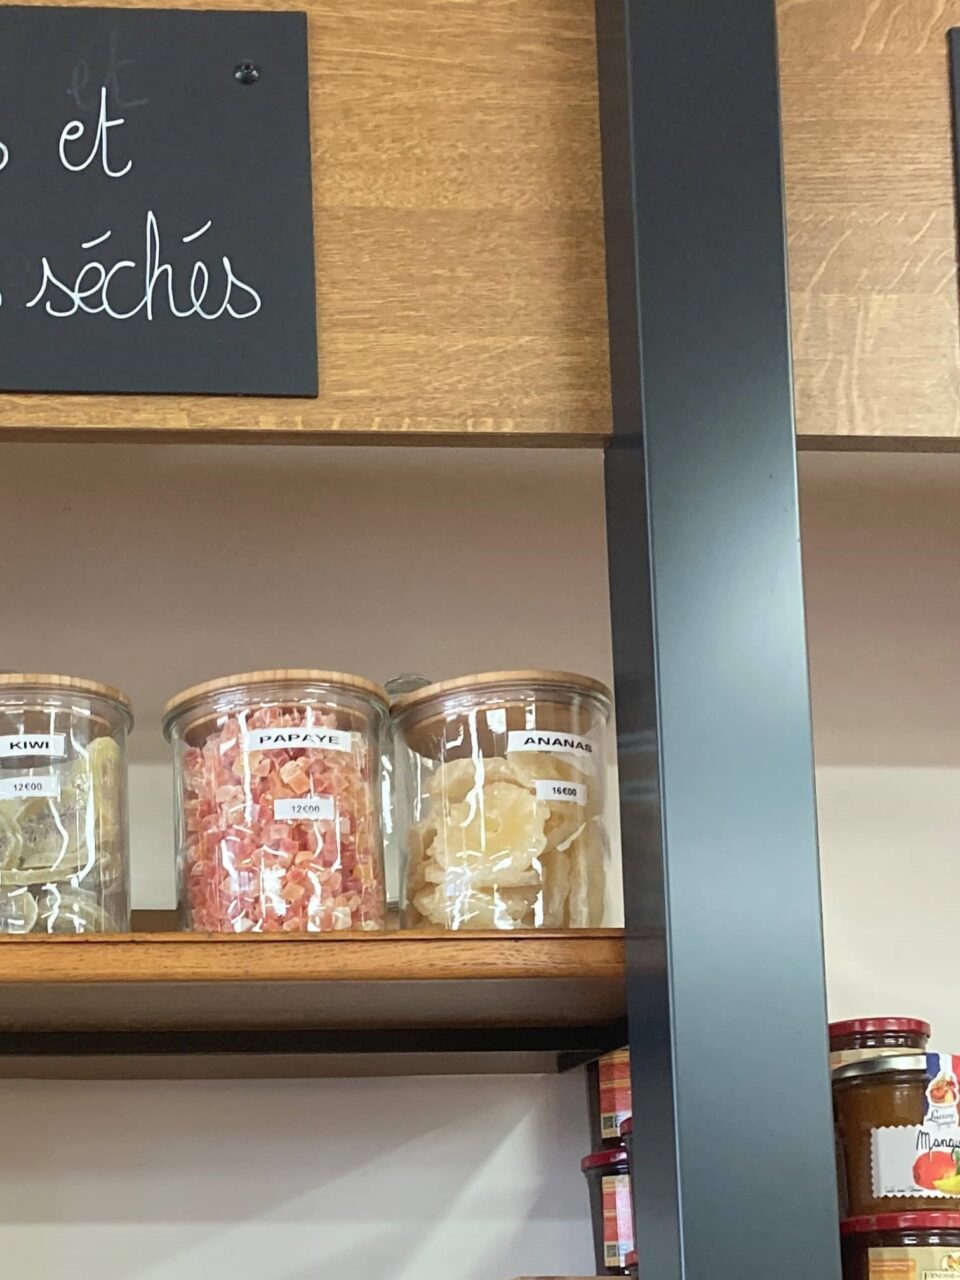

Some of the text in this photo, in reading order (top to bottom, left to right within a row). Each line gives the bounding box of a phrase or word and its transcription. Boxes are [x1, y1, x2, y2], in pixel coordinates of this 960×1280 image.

[58, 87, 132, 178] et
[26, 210, 262, 320] séchés
[259, 734, 340, 745] PAPAYE
[524, 737, 593, 753] ANANAS
[9, 741, 50, 750] KIWI
[13, 783, 43, 792] 12€00
[551, 786, 578, 797] 16€00
[291, 805, 321, 814] 12€00
